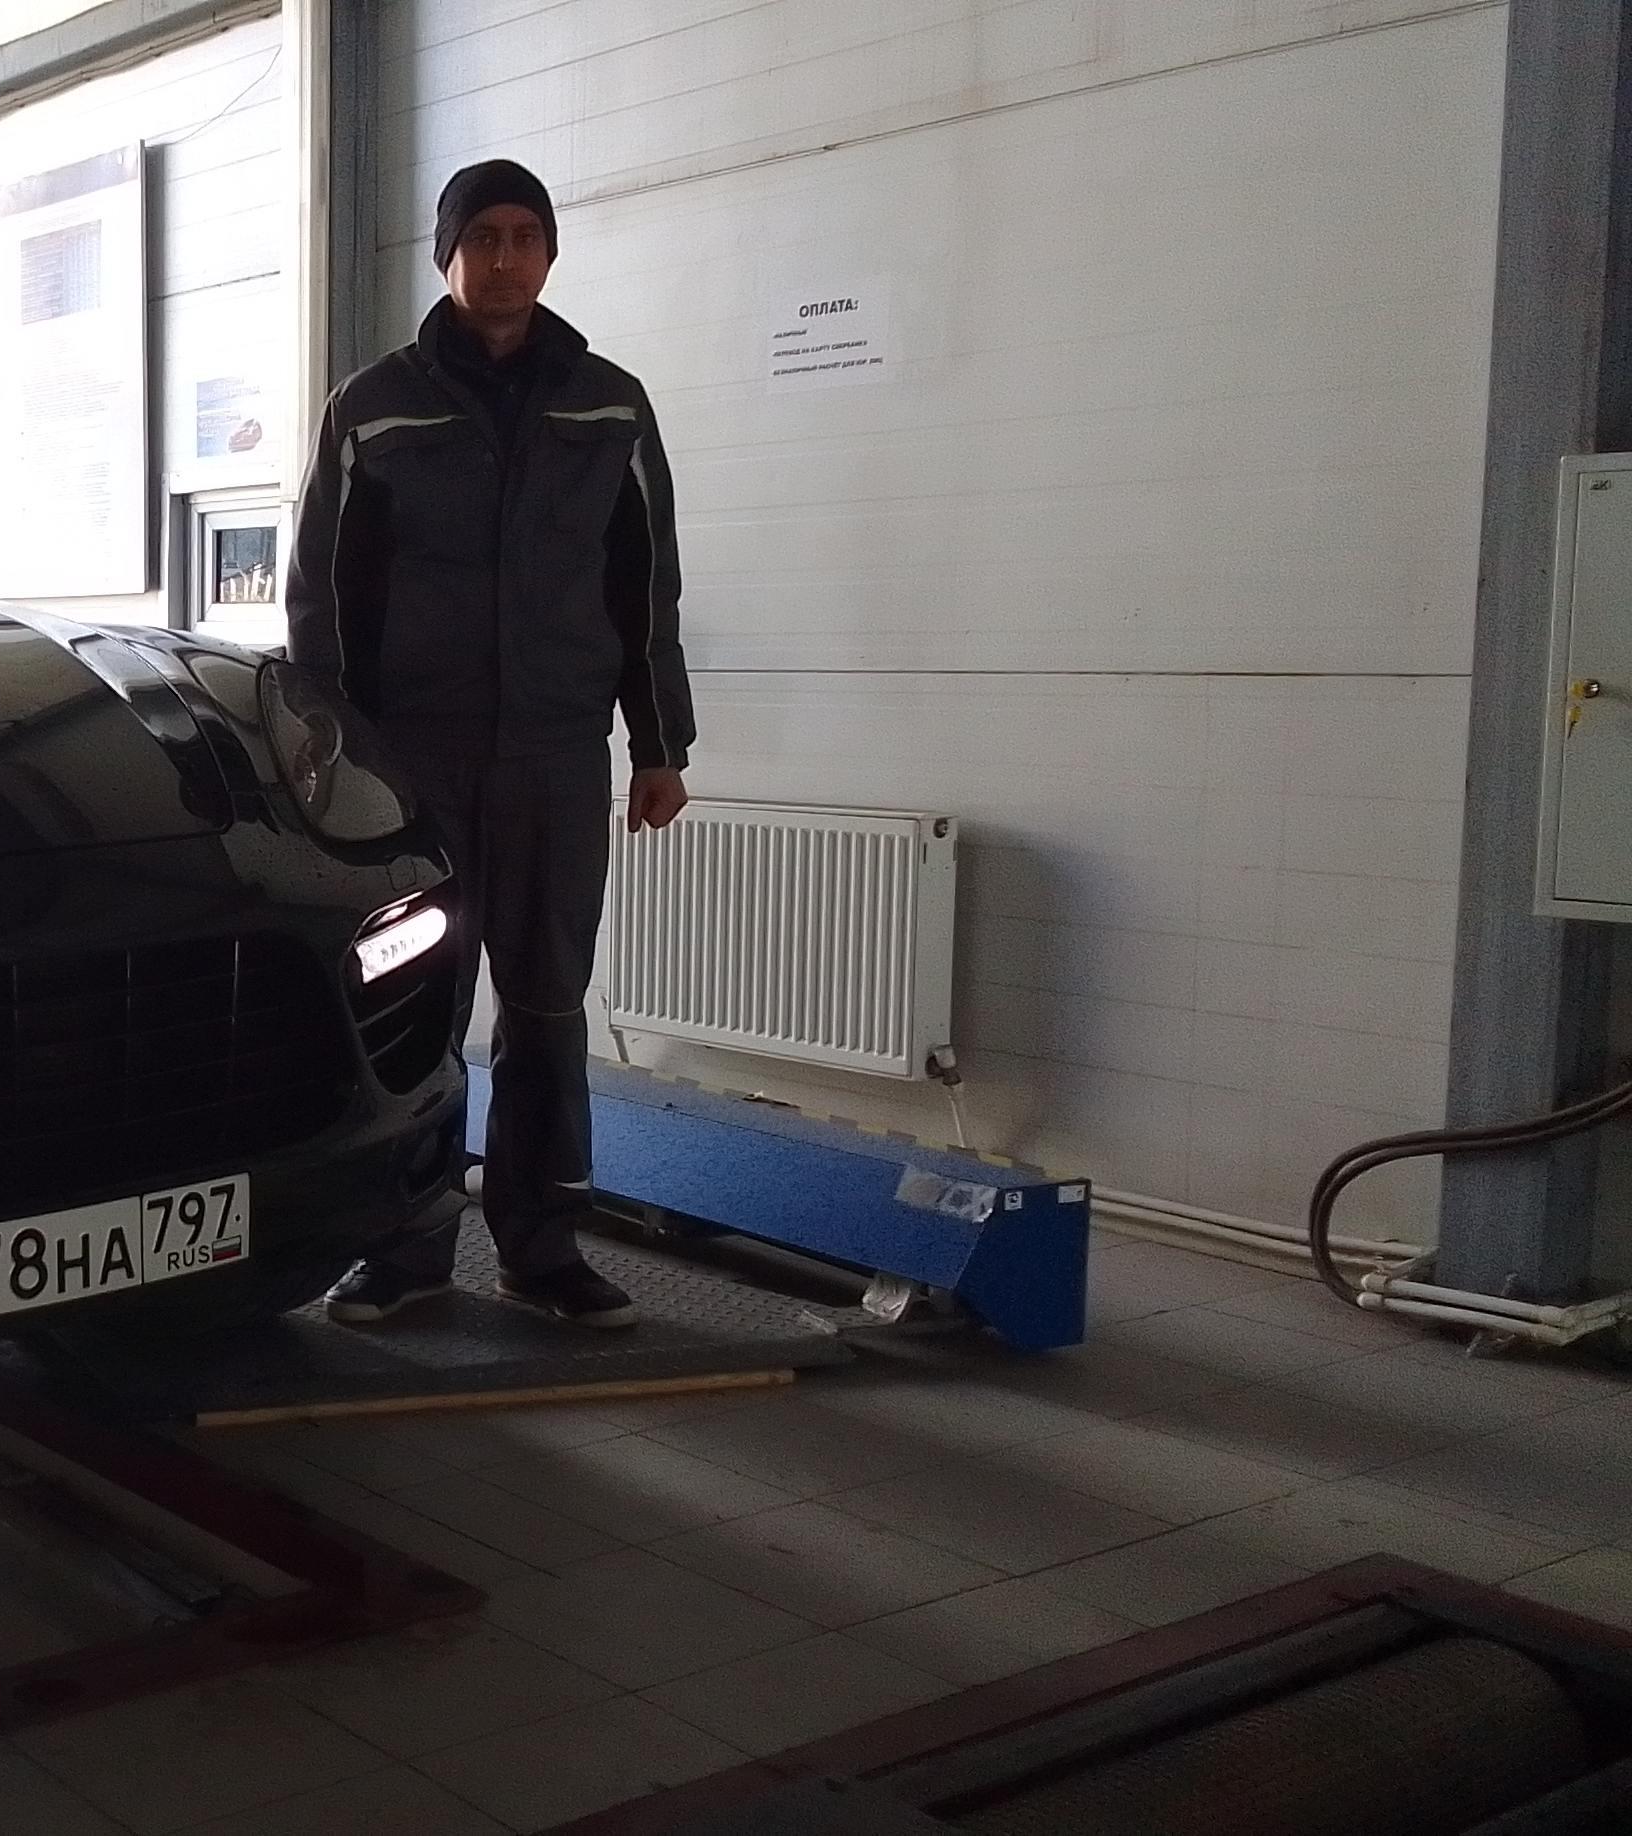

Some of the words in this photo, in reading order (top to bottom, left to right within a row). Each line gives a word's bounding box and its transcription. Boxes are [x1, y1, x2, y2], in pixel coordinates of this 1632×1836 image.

[799, 298, 859, 318] ОПЛАТА:
[146, 1182, 236, 1255] 797
[167, 1245, 210, 1272] RUS
